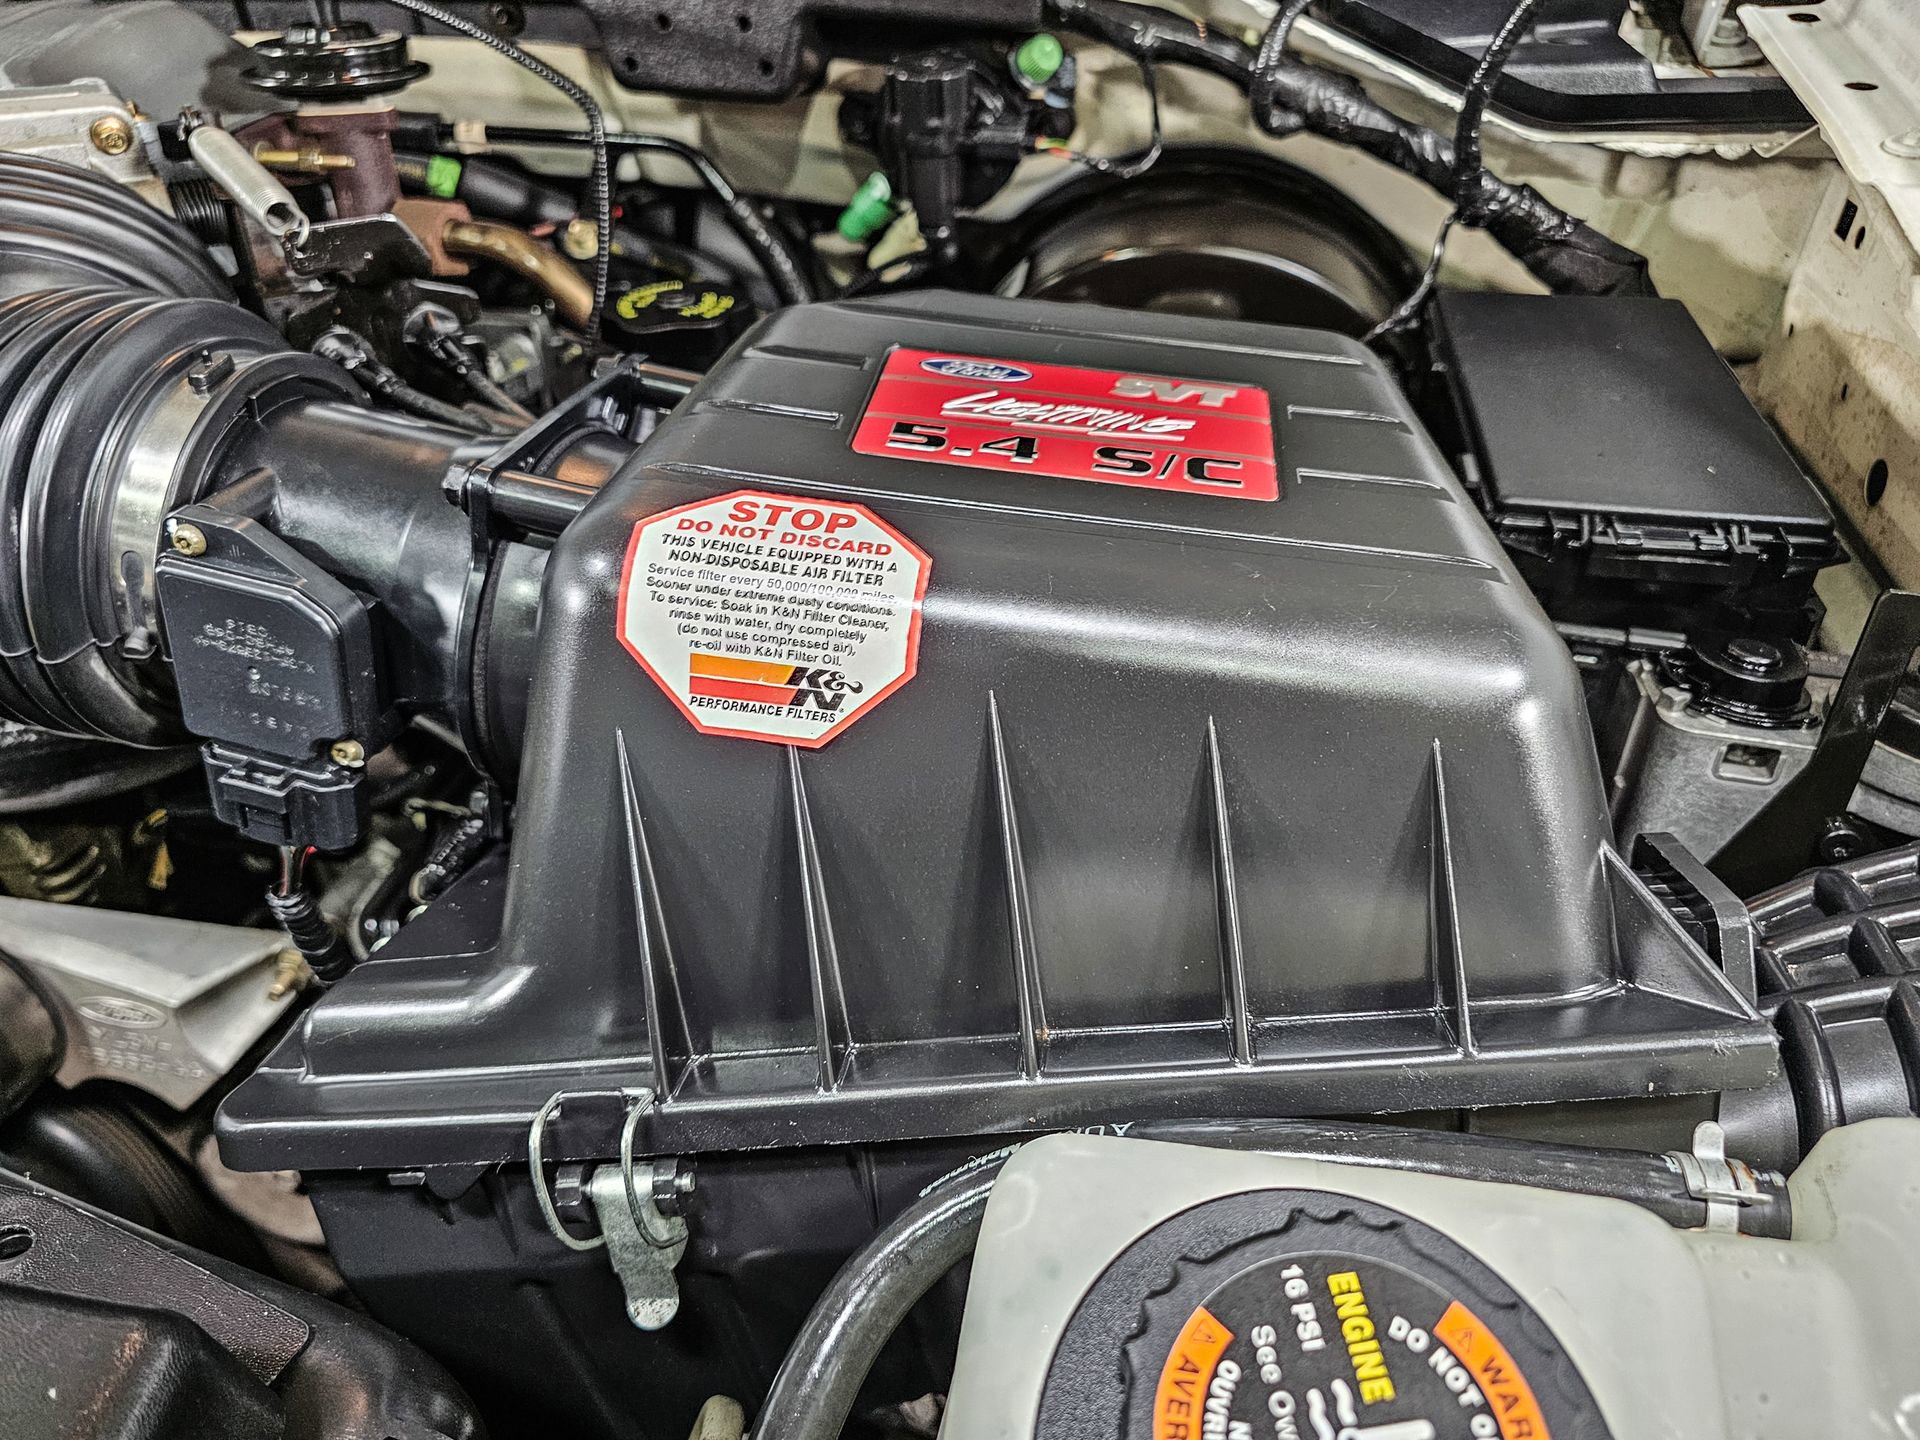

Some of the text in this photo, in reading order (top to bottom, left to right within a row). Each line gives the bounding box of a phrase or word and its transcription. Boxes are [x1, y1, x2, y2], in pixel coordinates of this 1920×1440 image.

[1111, 376, 1240, 407] SVT
[886, 422, 1244, 488] 5.4 S/C
[728, 501, 857, 533] STOP
[662, 534, 898, 573] THIS VEHICLE EQUIPPED WITH A
[677, 519, 892, 556] DO NOT DISCARD
[648, 563, 694, 578] Service
[698, 569, 727, 582] filter
[729, 574, 764, 589] every
[668, 549, 884, 586] NON-DISPOSABLE AIR FILTER
[646, 576, 896, 616] Sooner under extreme dusty conditions.
[650, 590, 890, 632] To service: Soak in K&N Filter Cleaner,
[668, 607, 867, 644] rinse with water, dry completely
[677, 622, 856, 657] (do not use compressed air),
[689, 639, 842, 667] re-oil with K&N Filter Oil.
[689, 696, 836, 723] PERFORMANCE FILTERS
[1280, 1264, 1327, 1352] 16 PSI
[1251, 1325, 1282, 1385] See
[1327, 1271, 1396, 1405] ENGINE
[1388, 1316, 1430, 1353] DO
[1428, 1346, 1485, 1408] NOT
